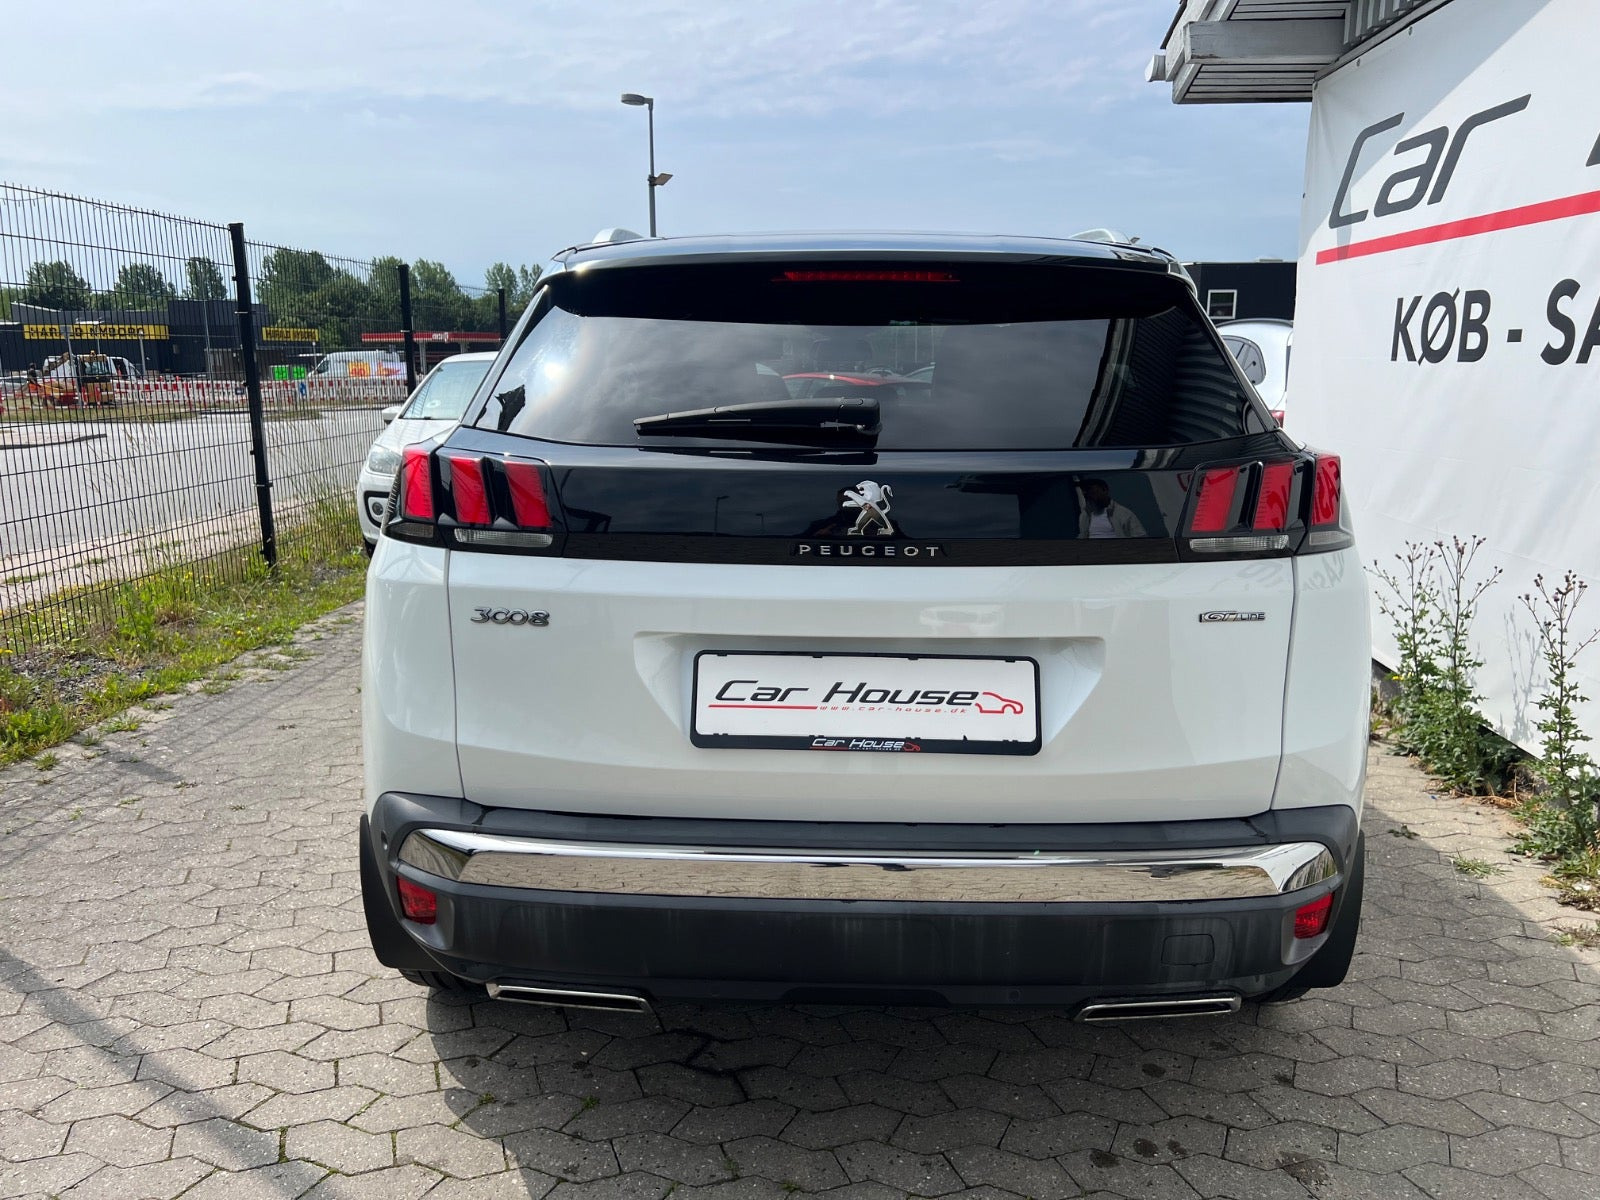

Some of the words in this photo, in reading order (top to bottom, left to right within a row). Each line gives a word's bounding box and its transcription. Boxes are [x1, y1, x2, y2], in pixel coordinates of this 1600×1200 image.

[1329, 93, 1531, 229] Car
[1390, 287, 1491, 366] KØB
[799, 545, 939, 557] PEUGEOT
[470, 606, 550, 627] 3008
[715, 680, 809, 702] Car
[822, 682, 979, 706] House
[819, 705, 967, 714] www.car-house.dk
[812, 738, 845, 747] Car
[849, 739, 905, 749] House
